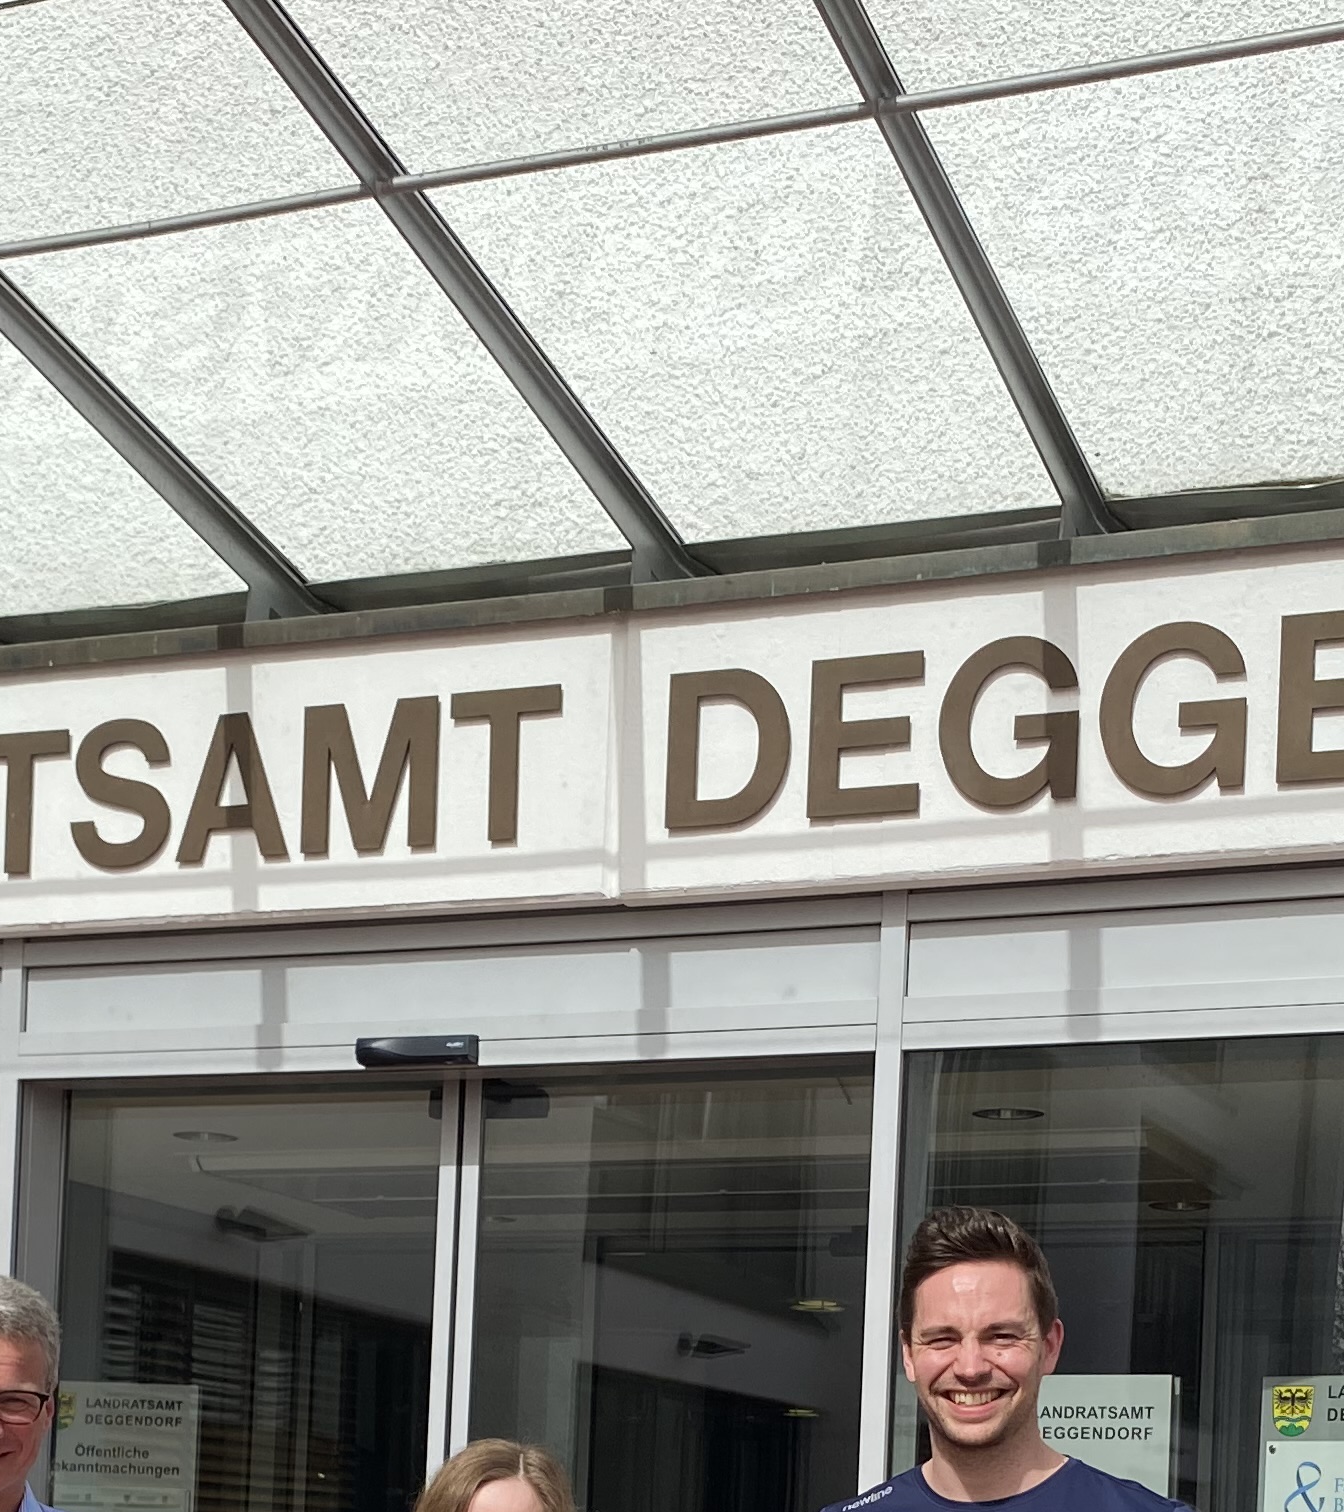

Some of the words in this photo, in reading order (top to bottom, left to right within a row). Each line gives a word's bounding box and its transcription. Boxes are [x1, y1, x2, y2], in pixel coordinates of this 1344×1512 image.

[86, 1398, 184, 1412] LANDRATSAMT
[1038, 1406, 1155, 1420] ANDRATSAMT
[85, 1414, 183, 1427] DEGGENDORF
[1042, 1427, 1154, 1440] EGGENDORF
[74, 1442, 150, 1459] Öffentliche
[53, 1460, 180, 1478] ekanntmachungen
